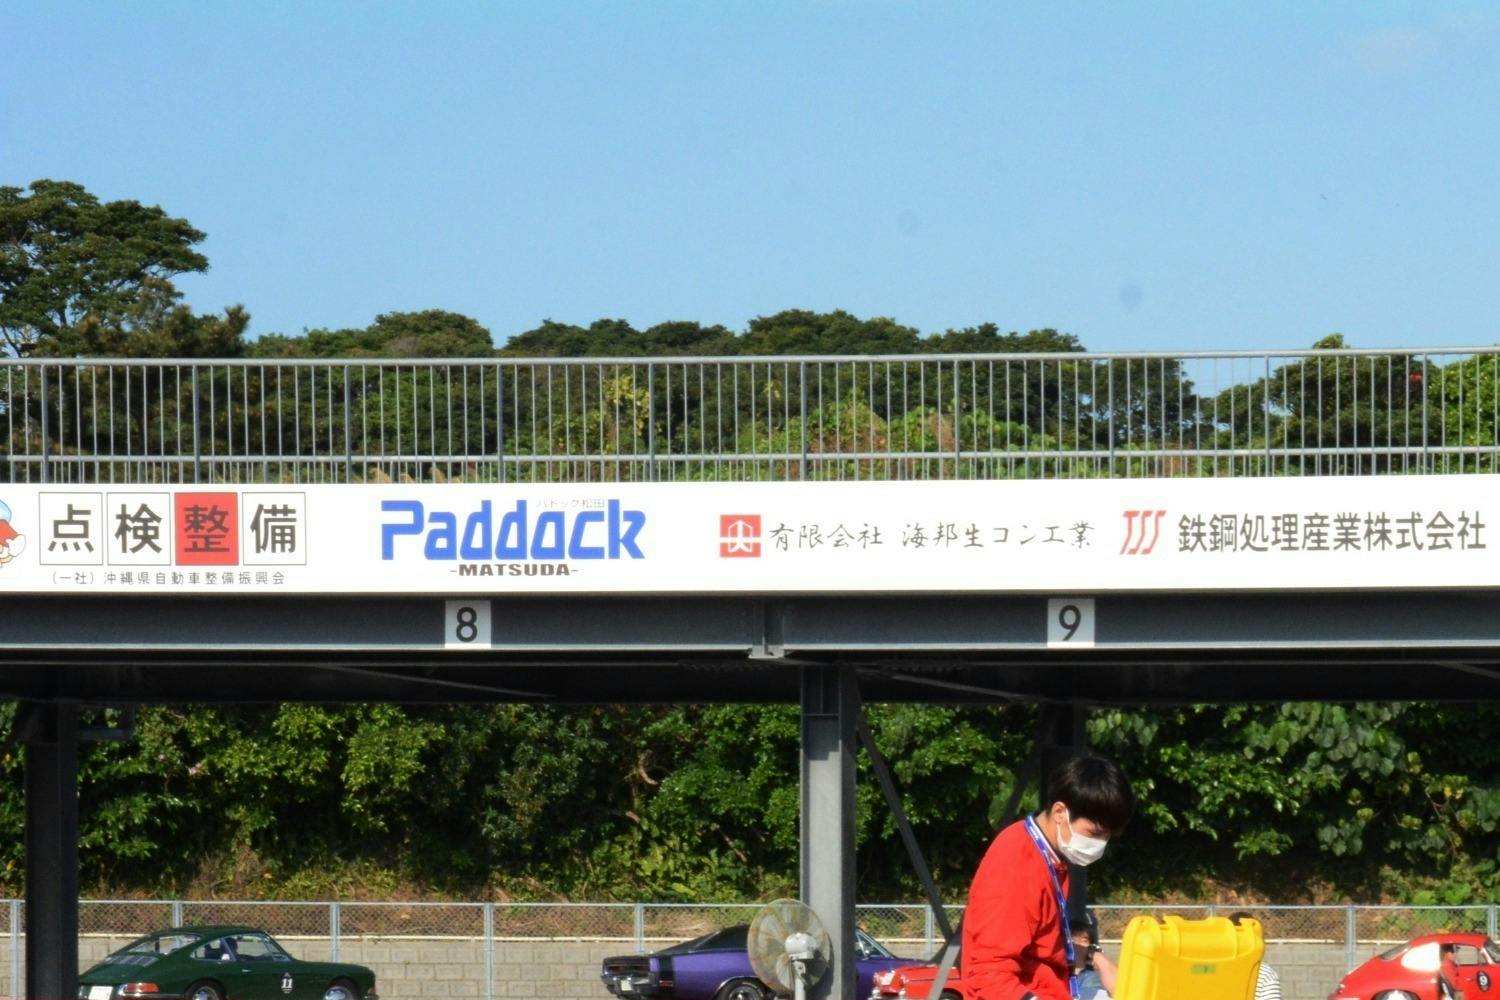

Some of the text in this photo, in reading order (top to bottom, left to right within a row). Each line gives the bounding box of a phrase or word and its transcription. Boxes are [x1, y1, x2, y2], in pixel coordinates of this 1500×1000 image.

[47, 503, 297, 554] 点検整備
[381, 499, 646, 561] Paddock
[769, 523, 884, 551] 有限会社
[1178, 511, 1487, 553] 鉄鋼処理産業株式会社
[456, 606, 478, 642] 8
[1058, 604, 1081, 642] 9
